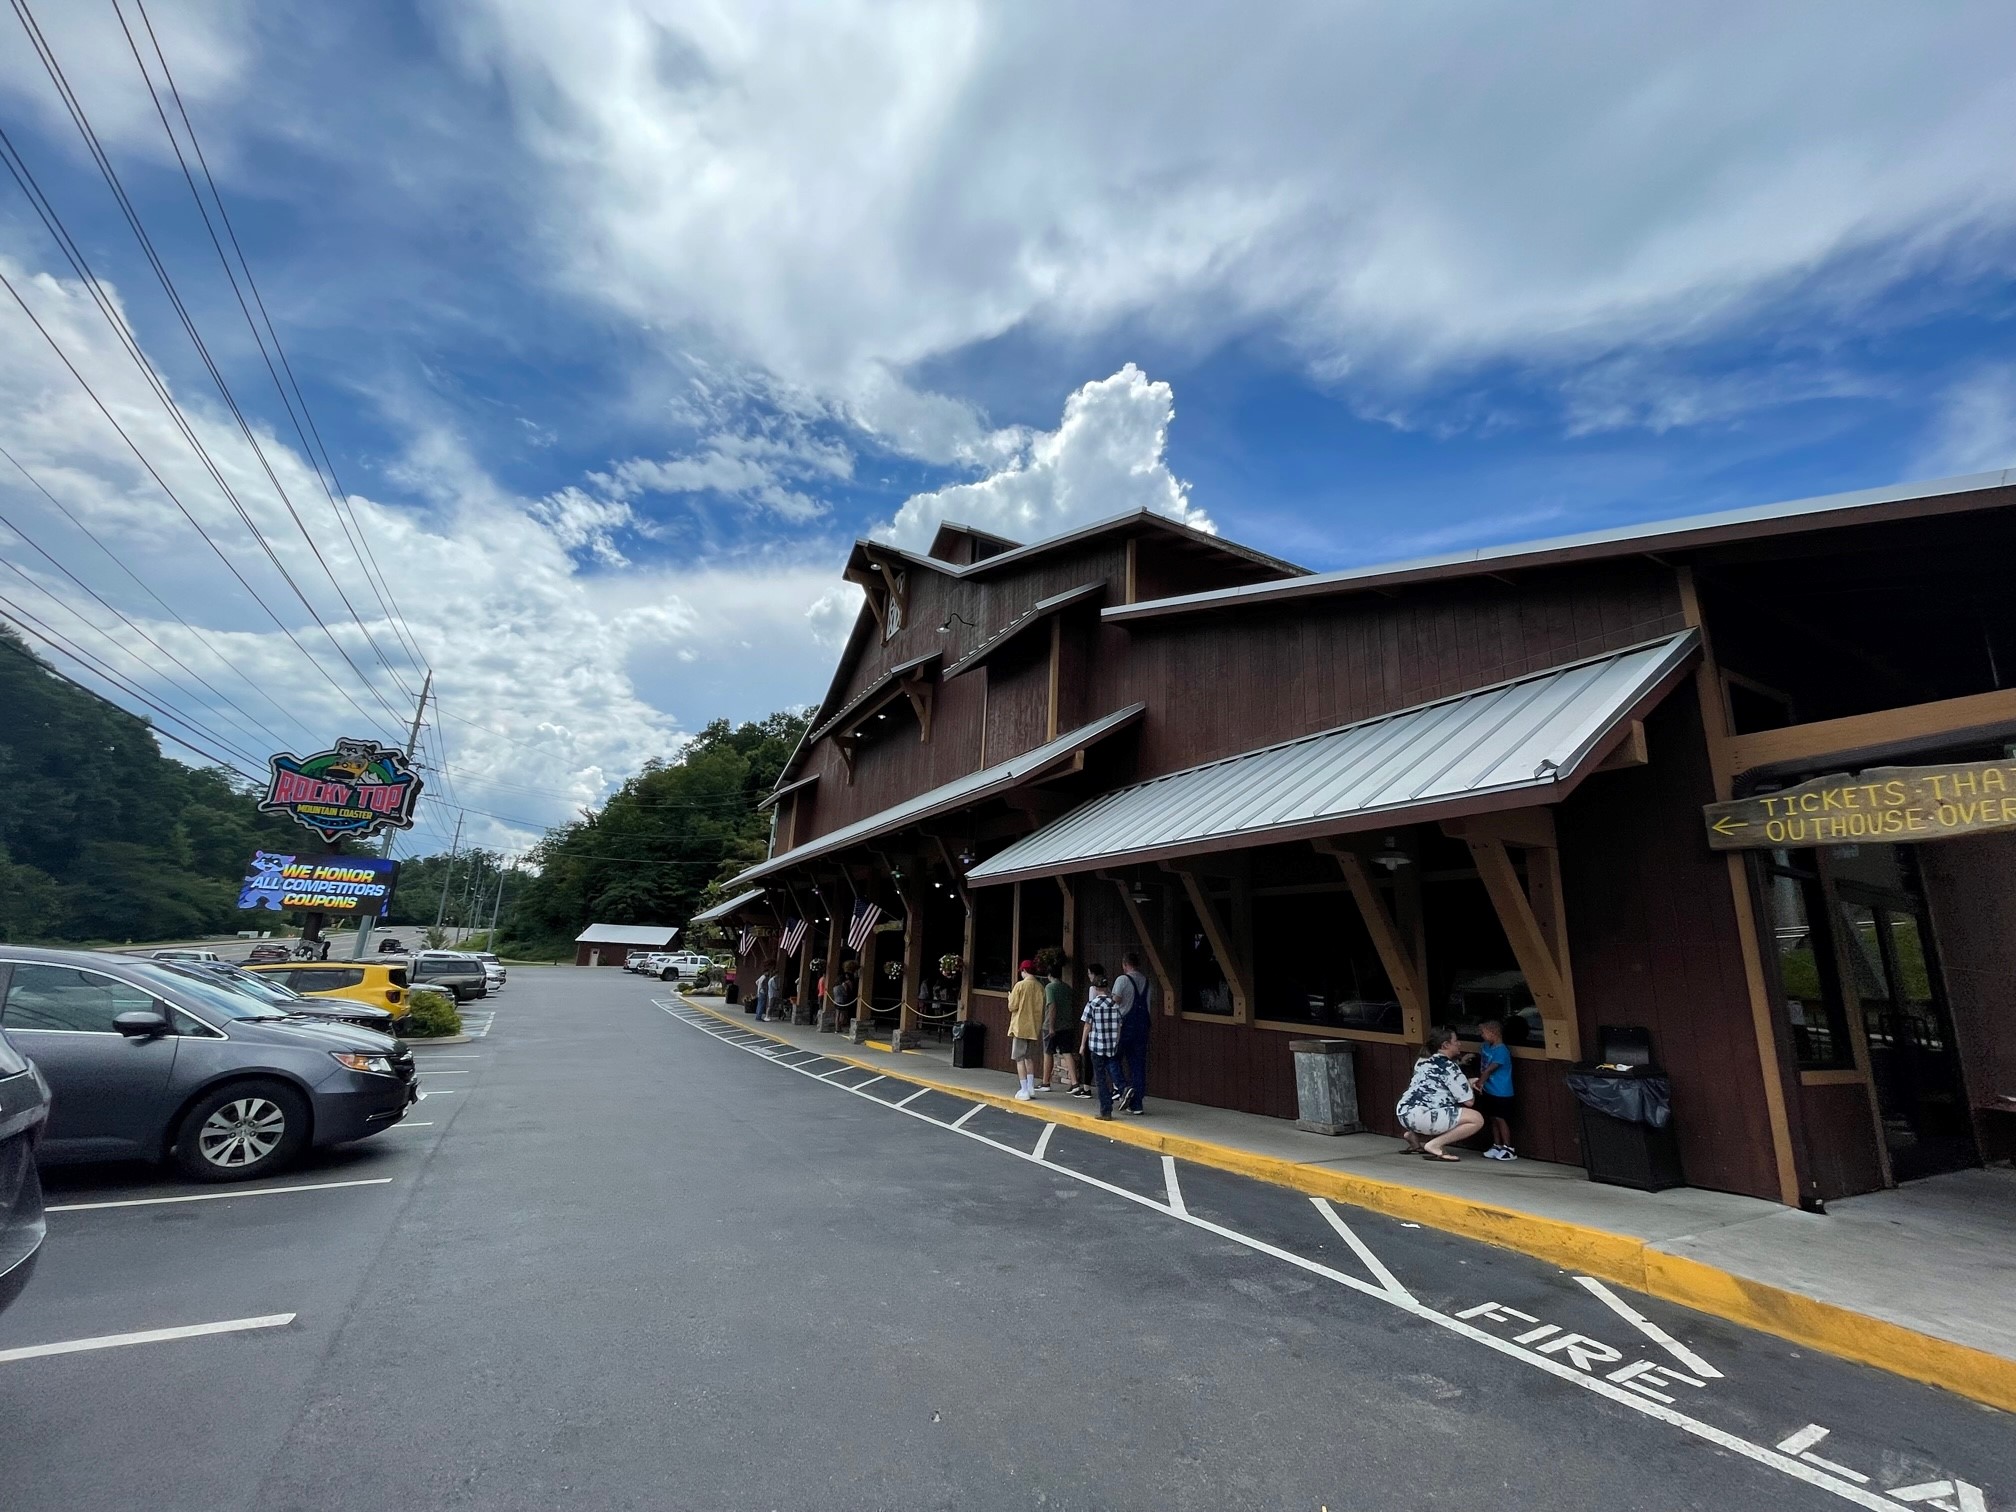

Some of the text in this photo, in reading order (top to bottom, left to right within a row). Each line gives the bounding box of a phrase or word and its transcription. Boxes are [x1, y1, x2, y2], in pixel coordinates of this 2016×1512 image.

[274, 769, 406, 815] ROCKY TOP
[1759, 768, 2016, 817] TICKETS THA
[297, 804, 373, 820] MOUNTAIN COASTER
[1765, 808, 1927, 842] OUTHOUSE
[250, 876, 386, 897] ALL COMPETITORS
[282, 864, 375, 883] WE HONOR
[283, 894, 358, 909] COUPONS
[1454, 1301, 1707, 1404] FIRE
